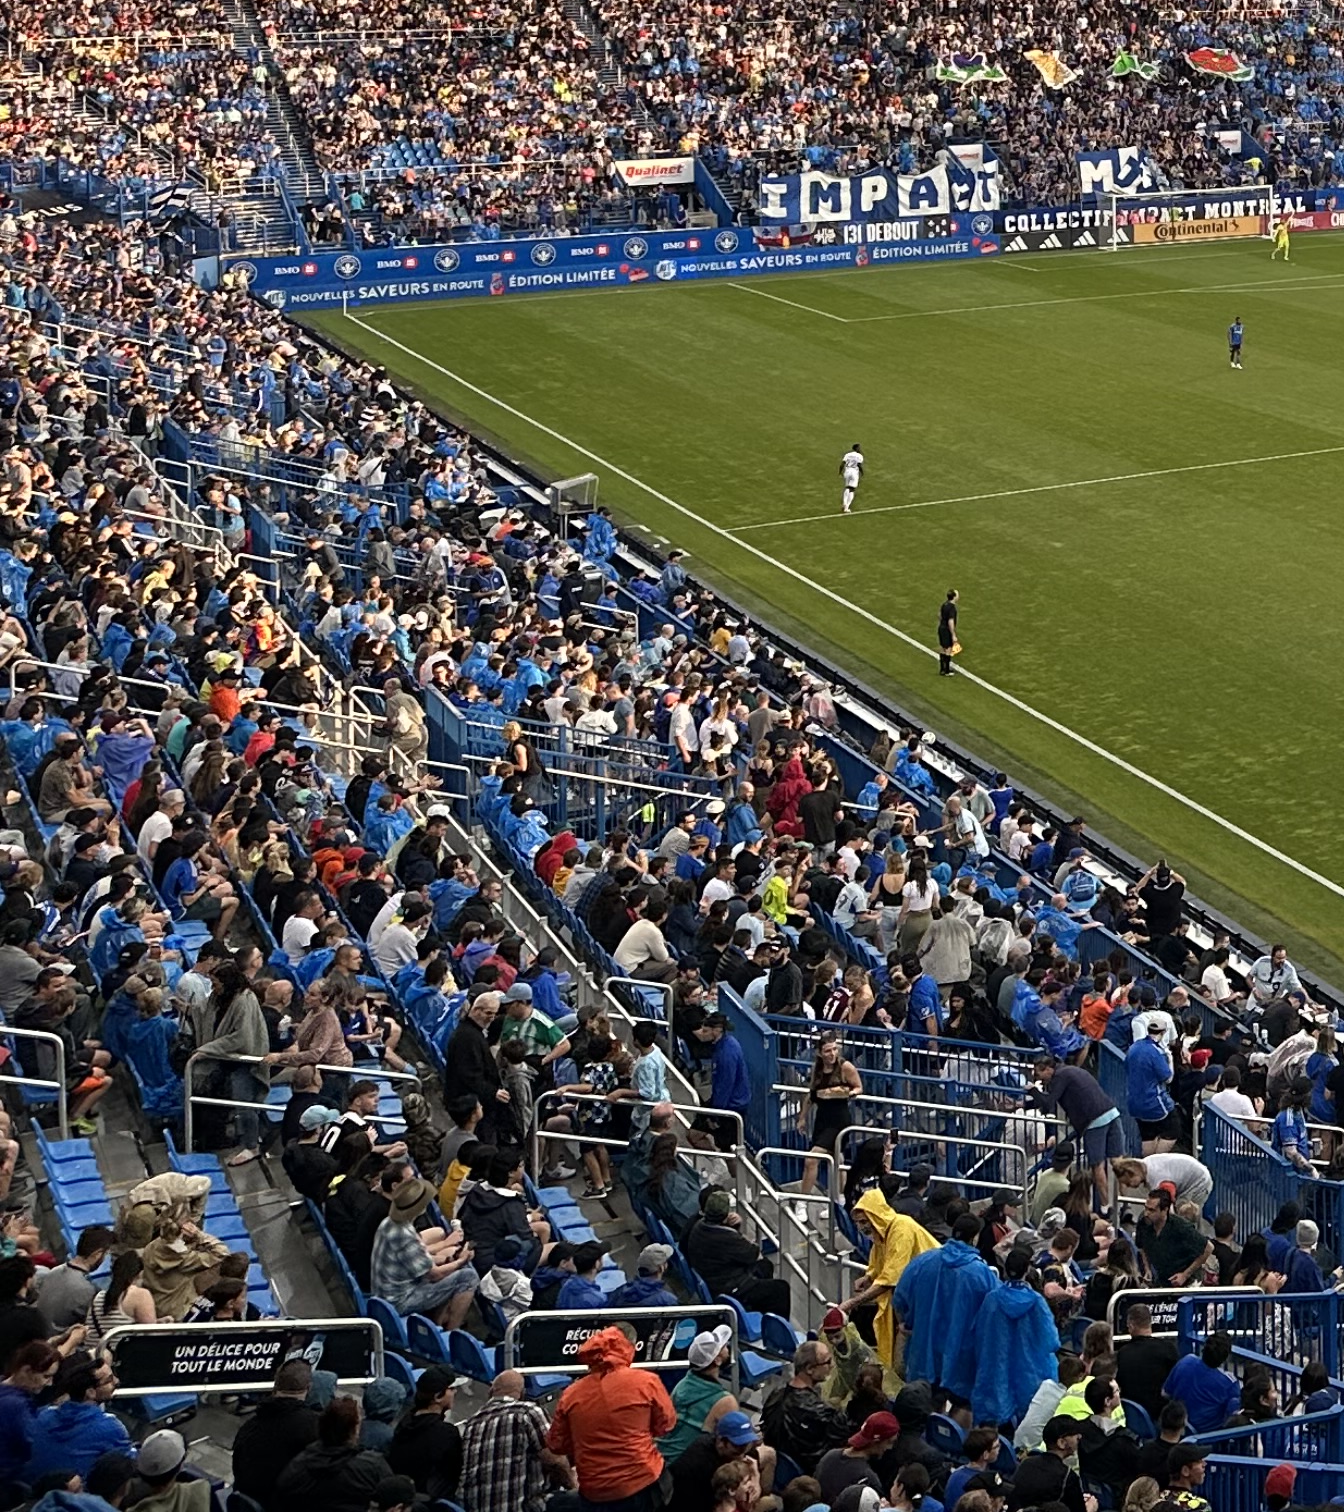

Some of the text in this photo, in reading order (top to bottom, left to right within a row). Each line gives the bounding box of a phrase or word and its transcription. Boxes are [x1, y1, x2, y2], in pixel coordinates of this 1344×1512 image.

[625, 164, 684, 178] Qualinet
[38, 203, 83, 217] LUS
[1004, 209, 1111, 233] COLLECTIF
[1204, 194, 1307, 219] MONTRÉAL
[844, 221, 919, 244] 131 DEBOUT
[1154, 219, 1229, 241] Continental
[475, 254, 499, 262] BMO
[571, 248, 594, 256] BMO
[872, 240, 969, 260] ÉDITION LIMITÉE
[377, 260, 402, 269] BMO
[681, 260, 737, 273] NOUVELLES
[740, 255, 803, 270] SAVEURS
[806, 253, 818, 263] EN
[821, 252, 852, 262] ROUTE
[274, 267, 300, 276] BMO
[508, 267, 616, 288] ÉDITION LIMITÉE
[291, 289, 355, 303] NOUVELLES
[358, 282, 430, 299] SAVEURS
[433, 283, 449, 292] EN
[451, 279, 484, 290] ROUTE
[174, 1345, 195, 1358] UN
[197, 1342, 243, 1357] DÉLICE
[246, 1342, 281, 1355] POUR
[171, 1357, 273, 1374] TOUT LE MONDE
